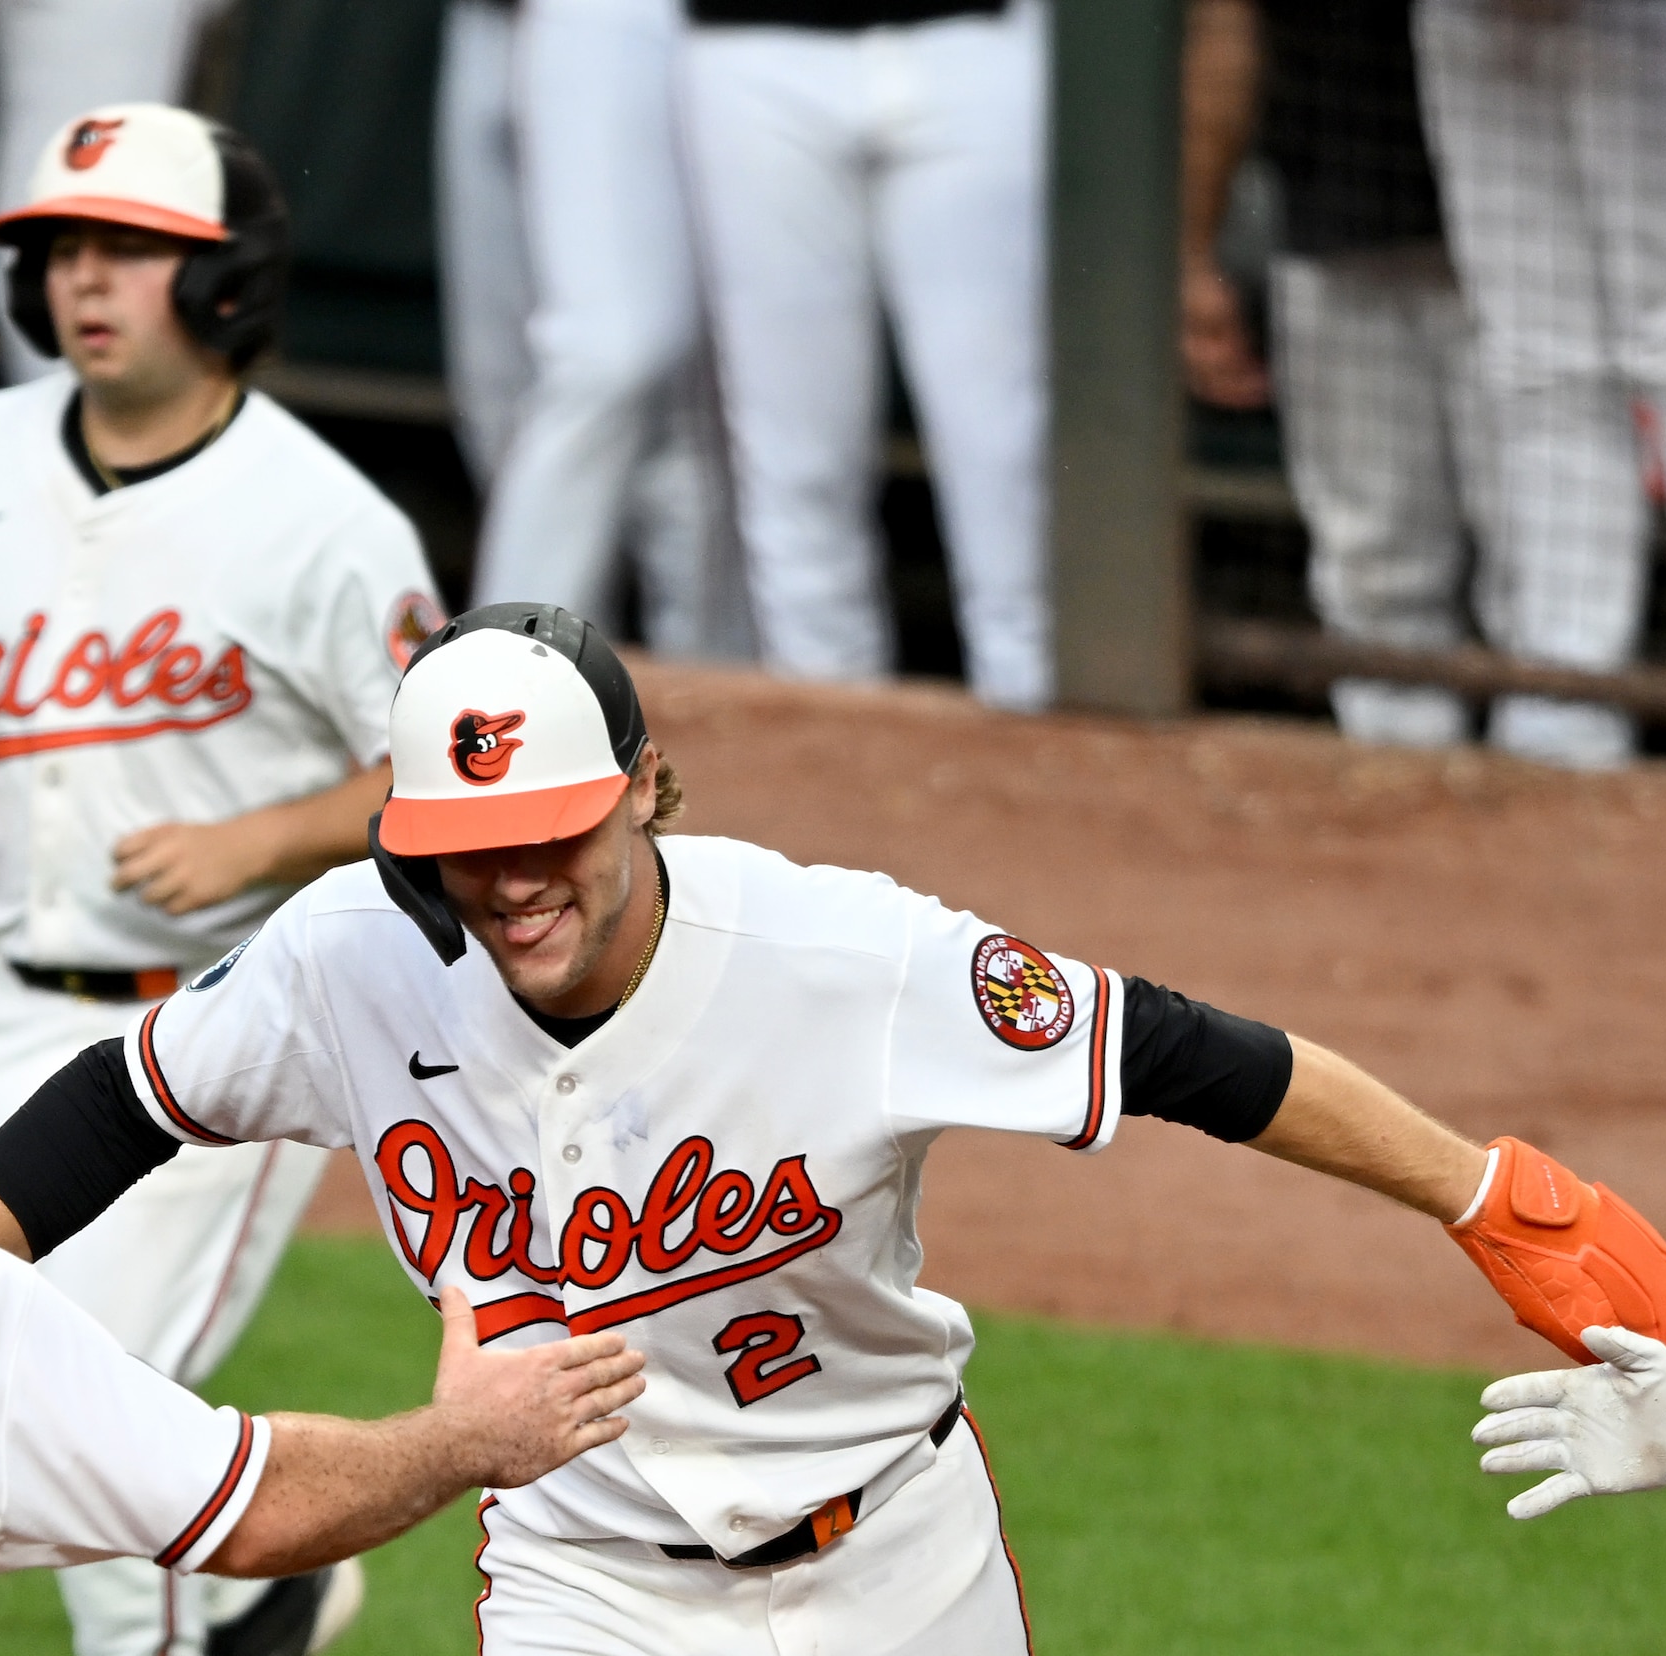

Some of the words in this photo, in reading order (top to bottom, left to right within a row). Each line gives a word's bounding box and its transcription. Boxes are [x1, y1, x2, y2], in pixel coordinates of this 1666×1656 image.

[976, 939, 1008, 1028] BALTIMORE
[1045, 969, 1071, 1040] ORIOLES
[376, 1119, 843, 1291] Orioles
[713, 1311, 822, 1409] 2
[825, 1507, 840, 1536] 2
